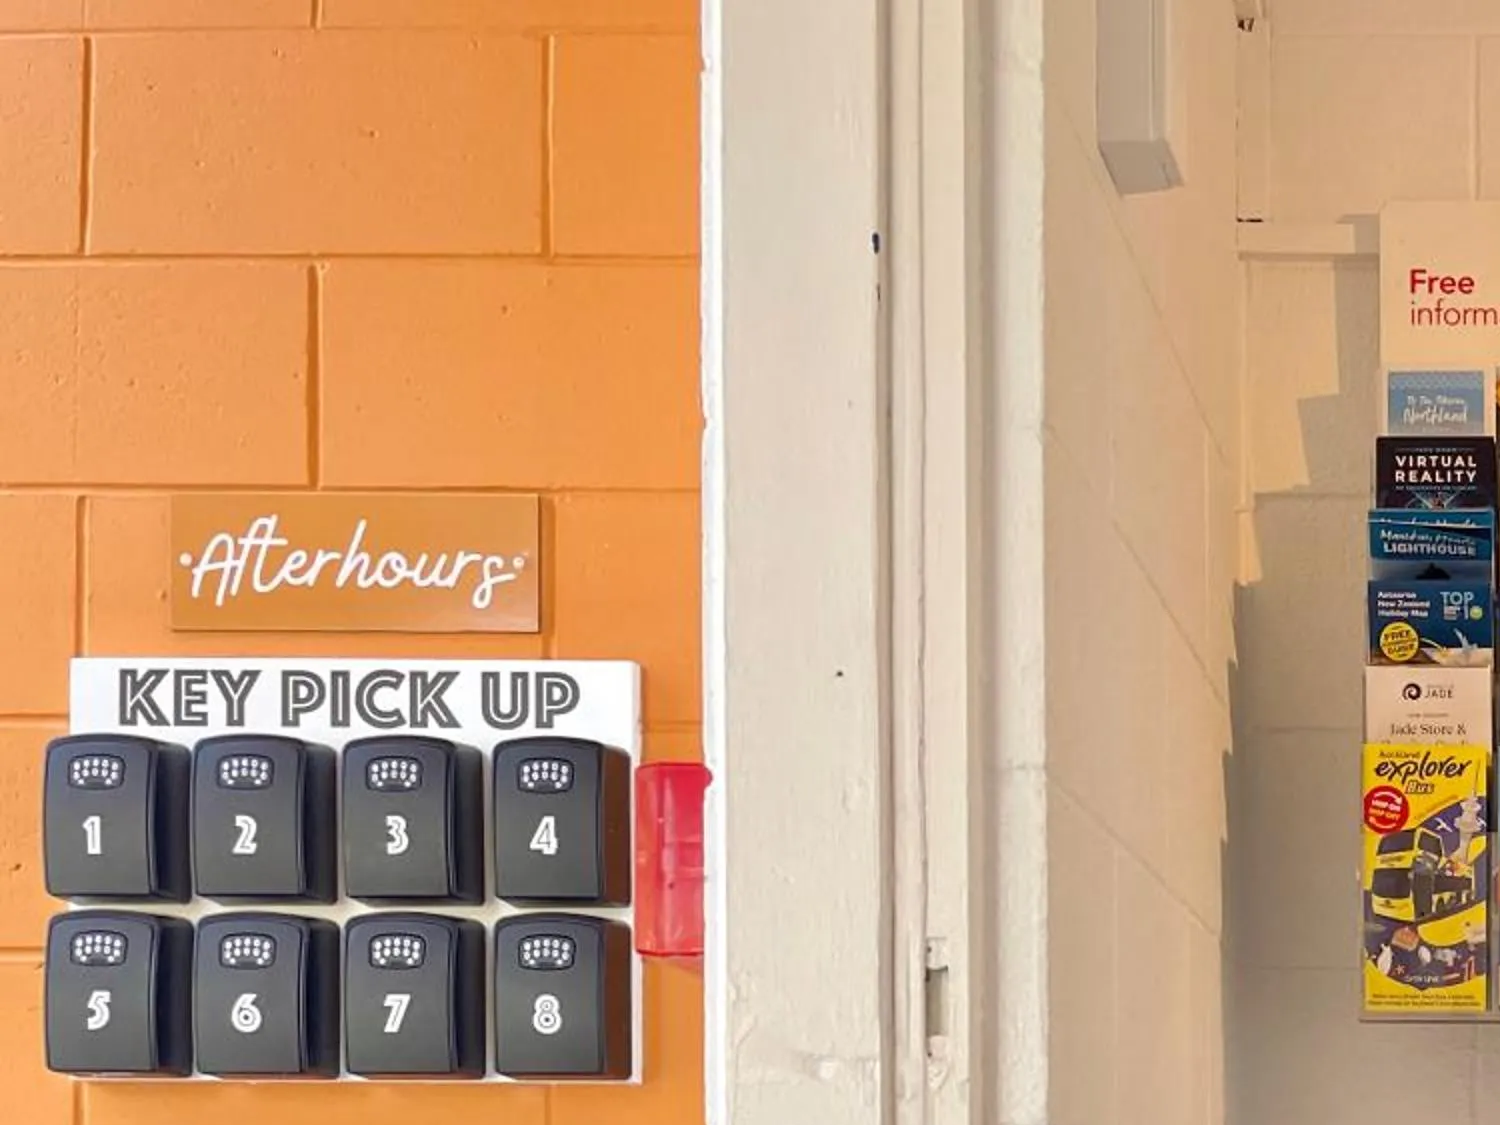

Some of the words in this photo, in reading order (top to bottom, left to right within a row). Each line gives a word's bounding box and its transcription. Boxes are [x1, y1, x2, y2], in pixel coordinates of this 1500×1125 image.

[1409, 269, 1475, 295] Free
[1395, 455, 1477, 468] VIRTUAL
[1395, 470, 1477, 483] REALITY
[191, 514, 515, 609] Afterhours
[1383, 541, 1478, 556] LIGHTHOUSE
[1377, 600, 1397, 608] New
[1440, 591, 1475, 606] TOP
[118, 668, 262, 729] KEY
[279, 668, 462, 730] PICK
[481, 670, 582, 730] UP
[1424, 688, 1454, 700] JADE
[1390, 723, 1416, 736] Jade
[1420, 723, 1453, 736] Store
[1374, 751, 1473, 785] explorer
[82, 815, 102, 855] 1
[231, 815, 258, 855] 2
[385, 816, 409, 856] 3
[529, 815, 558, 856] 4
[87, 991, 112, 1030] 5
[231, 994, 262, 1033] 6
[383, 994, 411, 1033] 7
[532, 994, 563, 1035] 8
